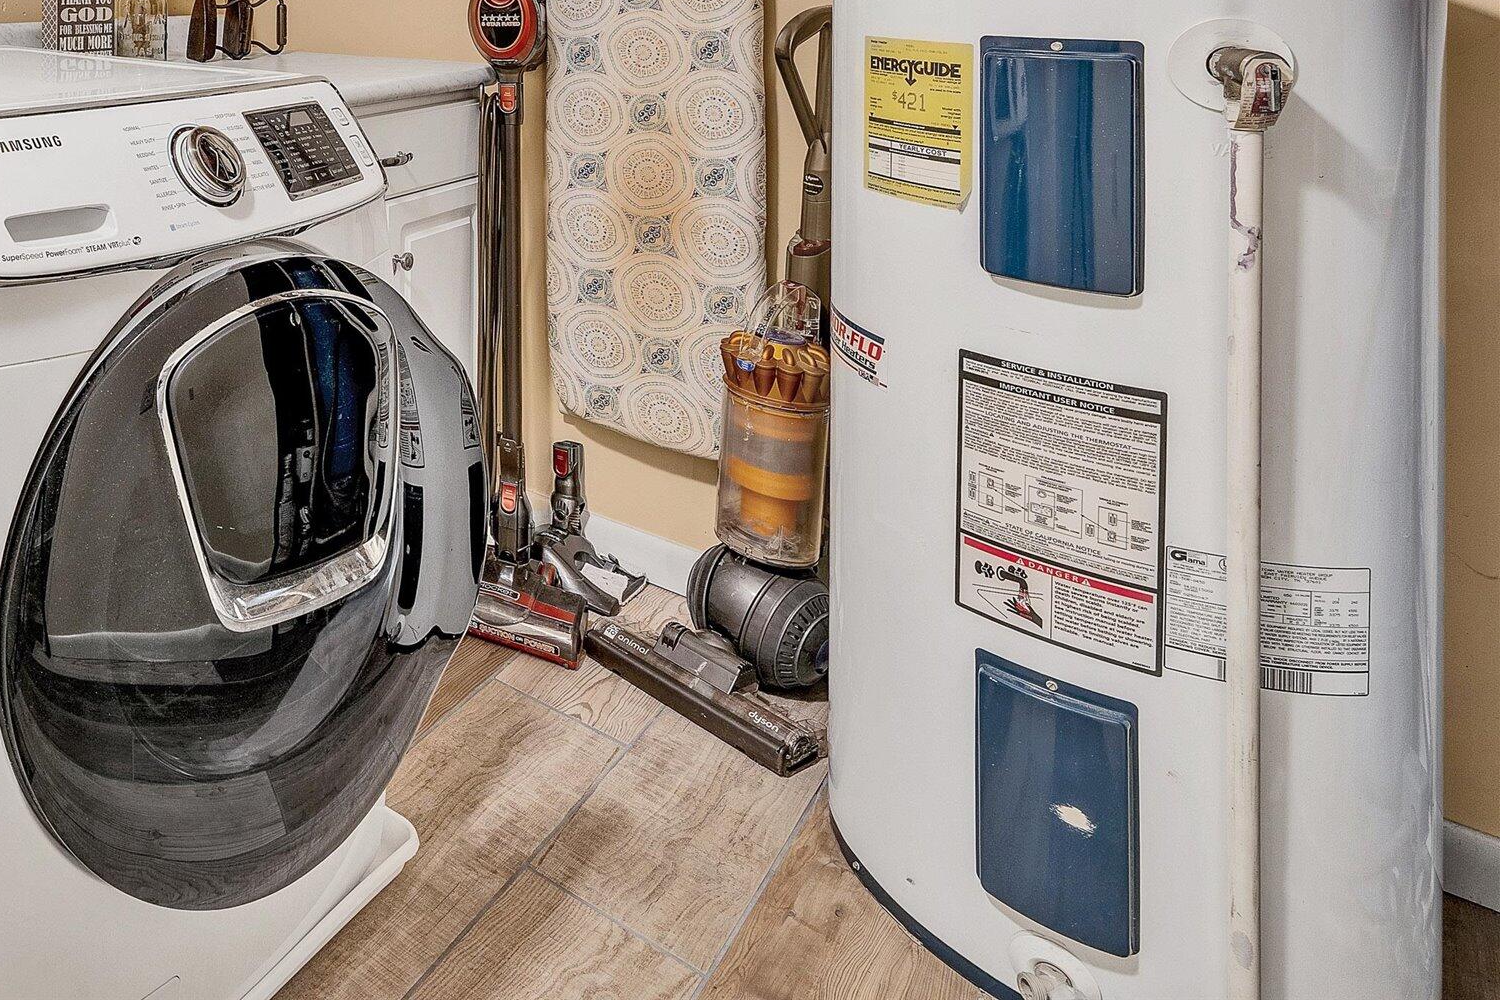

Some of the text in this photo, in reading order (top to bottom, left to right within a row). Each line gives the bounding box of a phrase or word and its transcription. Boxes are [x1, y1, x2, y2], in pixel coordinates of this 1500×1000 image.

[60, 6, 113, 23] GOD
[60, 23, 113, 34] FOR BLESSING ME
[59, 34, 113, 51] MUCH MORE
[870, 56, 961, 78] ENERGYGUIDE
[892, 90, 926, 112] $421
[136, 151, 156, 159] BEDDING
[900, 144, 947, 157] YEARLY COST
[1, 253, 44, 262] SuperSpeed
[85, 243, 107, 253] STEAM
[831, 313, 882, 361] OR-FLO
[841, 340, 876, 369] Heaters
[1001, 360, 1114, 391] SERVICE & INSTALLATION
[1000, 382, 1115, 414] IMPORTANT USER NOTICE
[985, 411, 1015, 422] LOCATING
[1032, 424, 1069, 437] ADJUSTING
[1085, 437, 1132, 450] THERMOSTAT
[1005, 523, 1022, 532] STATE
[1035, 532, 1074, 547] CALIFORNIA
[1075, 544, 1101, 555] NOTICE
[1170, 550, 1205, 565] Gama
[1028, 561, 1079, 583] DANGER
[1055, 581, 1106, 599] Water temperature
[1055, 590, 1070, 598] death
[1055, 595, 1135, 622] Children, disabled elderly
[1061, 602, 1140, 628] highest being scalded.
[1106, 601, 1131, 611] instantly
[1054, 610, 1073, 620] setting
[1074, 617, 1108, 629] temperature
[1133, 633, 1153, 642] heater.
[1055, 620, 1088, 633] Temperature
[1089, 631, 1110, 641] limiting
[1065, 608, 1135, 632] instruction manual before
[479, 623, 515, 641] SUCTION
[524, 638, 555, 654] POWER
[617, 634, 650, 655] animal
[1054, 625, 1115, 647] available. manual.
[1080, 623, 1097, 631] before
[1097, 629, 1117, 638] bathing
[1125, 636, 1153, 648] showering.
[748, 711, 779, 732] dyson
